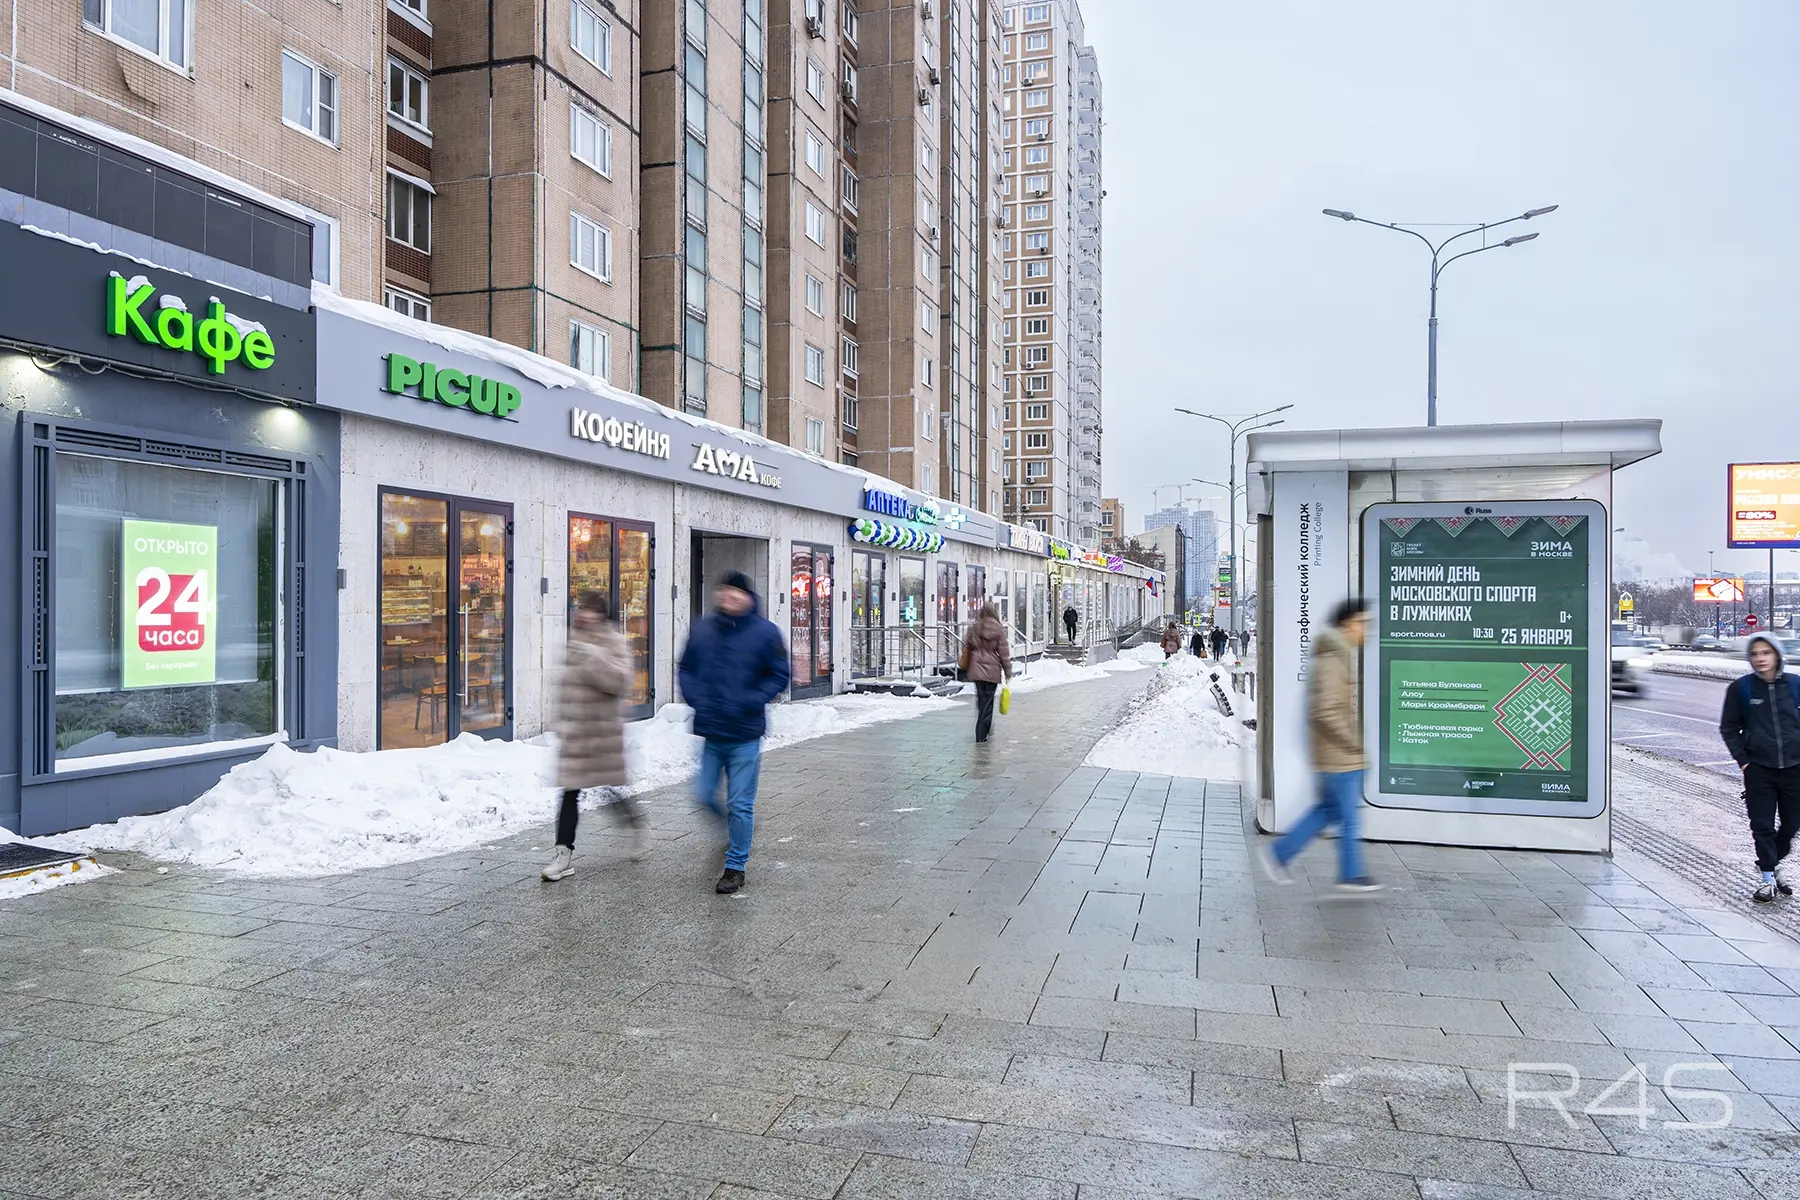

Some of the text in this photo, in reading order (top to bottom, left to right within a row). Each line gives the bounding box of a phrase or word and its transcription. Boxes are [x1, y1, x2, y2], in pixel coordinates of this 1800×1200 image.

[107, 272, 276, 374] Кафе
[387, 352, 522, 418] PICUP
[571, 407, 670, 460] КОФЕЙНЯ
[760, 472, 782, 490] КОФЕ
[866, 488, 913, 520] АПТЕКА
[1313, 501, 1324, 567] Printing College
[134, 537, 208, 555] ОТКРЫТО
[1531, 541, 1573, 551] ЗИМА
[1390, 564, 1480, 583] ЗИМНИЙ ДЕНЬ
[136, 566, 213, 626] 24
[1297, 502, 1311, 682] Полиграфический колледж
[1390, 586, 1536, 602] МОСКОВСКОГО СПОРТА
[1390, 605, 1472, 621] В ЛУЖНИКАХ
[1560, 610, 1573, 623] 0+
[145, 629, 199, 646] часа
[1473, 627, 1494, 638] 10:30
[1501, 628, 1573, 645] 25 ЯНВАРЯ
[1428, 702, 1486, 710] Краймбрери
[1402, 723, 1456, 731] Тюбинговая
[1402, 730, 1440, 738] Лыжная
